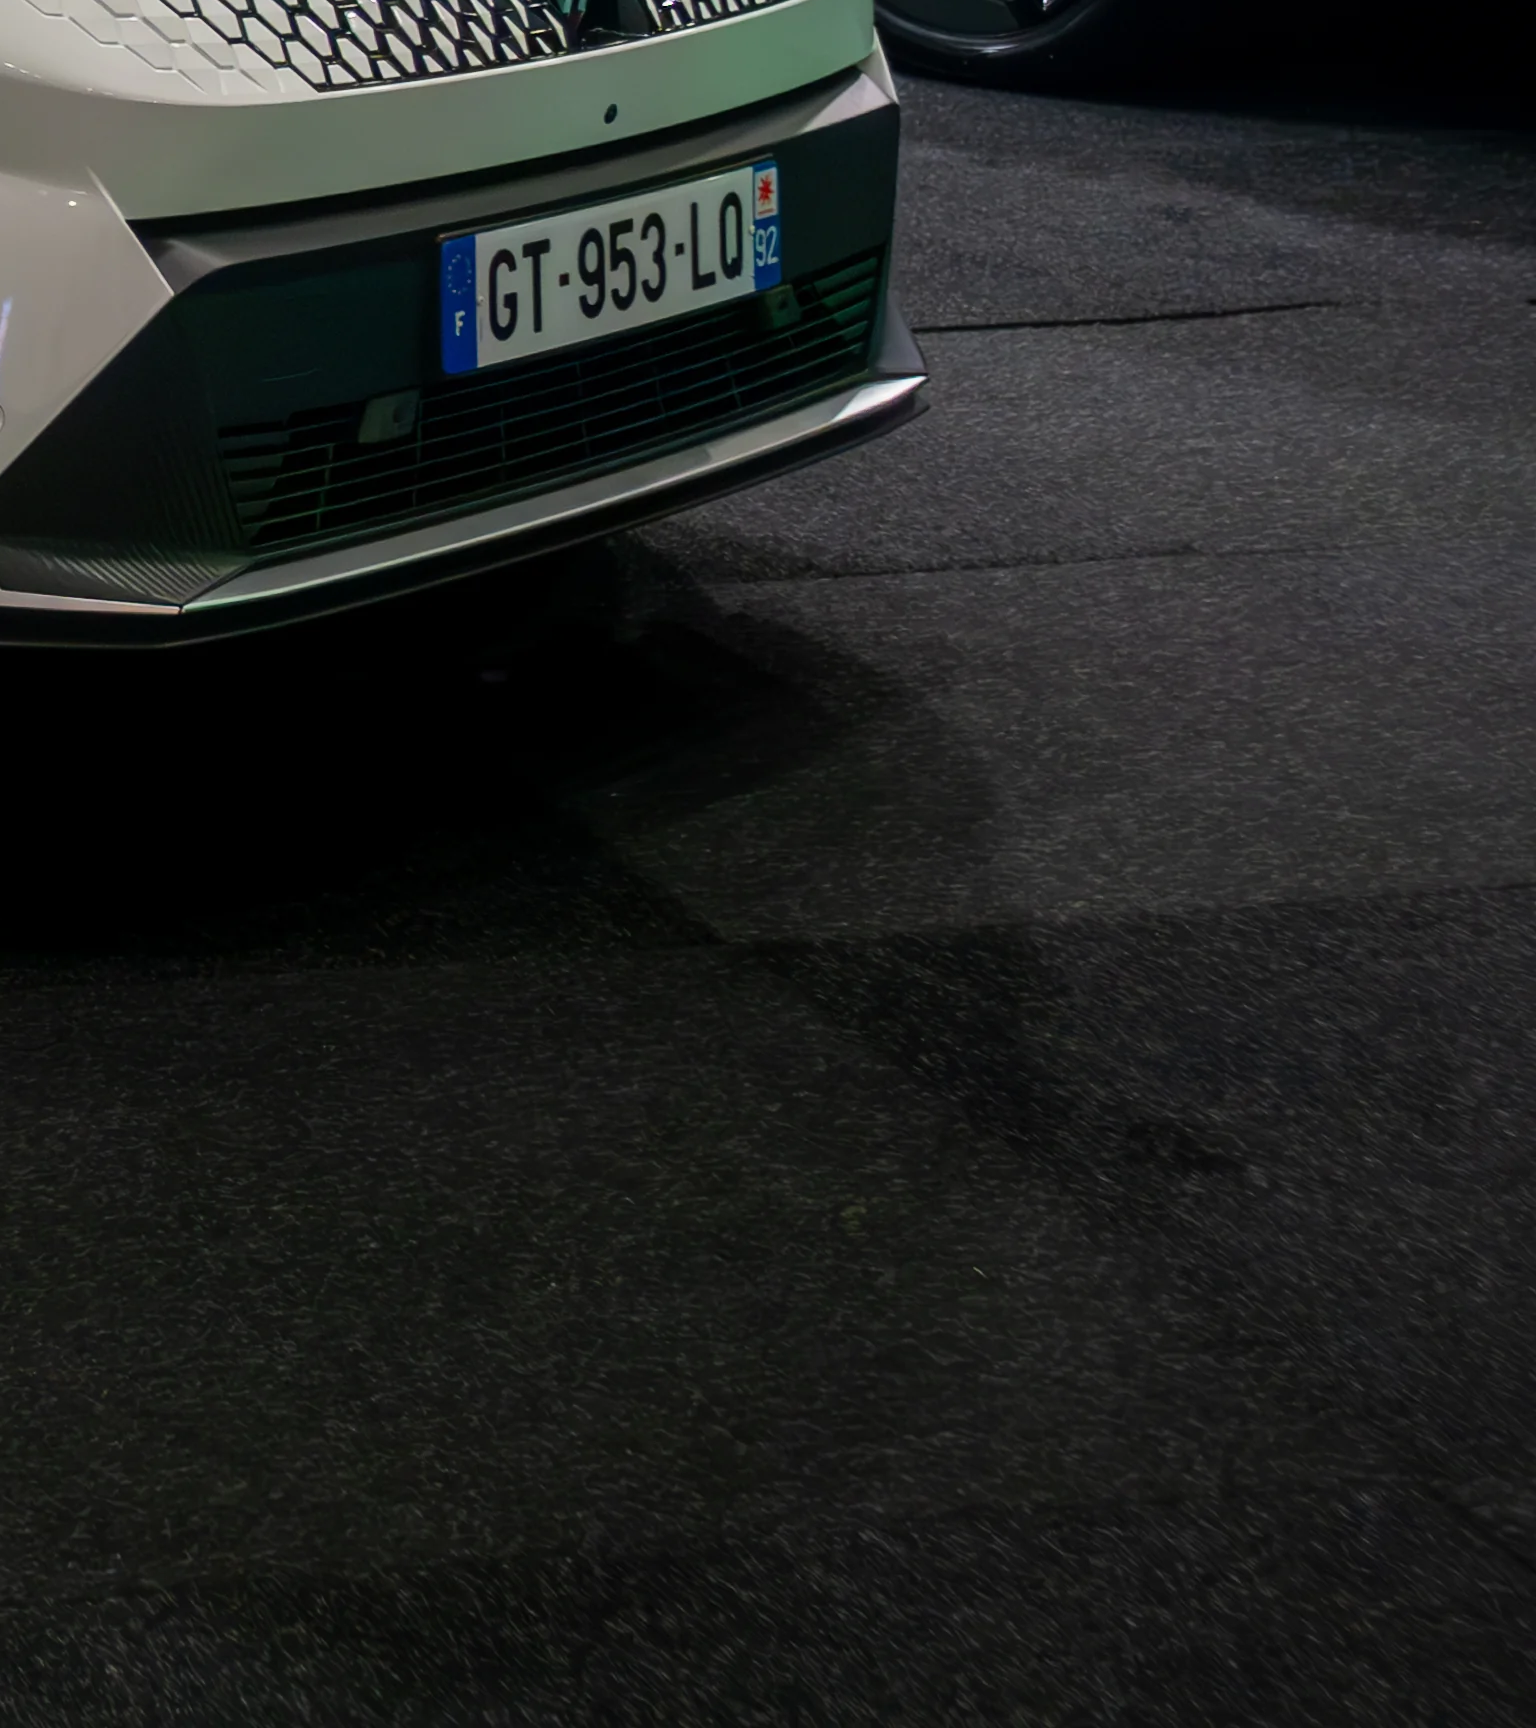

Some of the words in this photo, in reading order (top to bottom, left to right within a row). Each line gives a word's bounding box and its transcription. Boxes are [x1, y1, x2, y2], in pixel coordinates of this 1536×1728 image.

[455, 310, 466, 336] F
[488, 191, 743, 342] GT-953-LQ
[755, 225, 780, 267] 92
